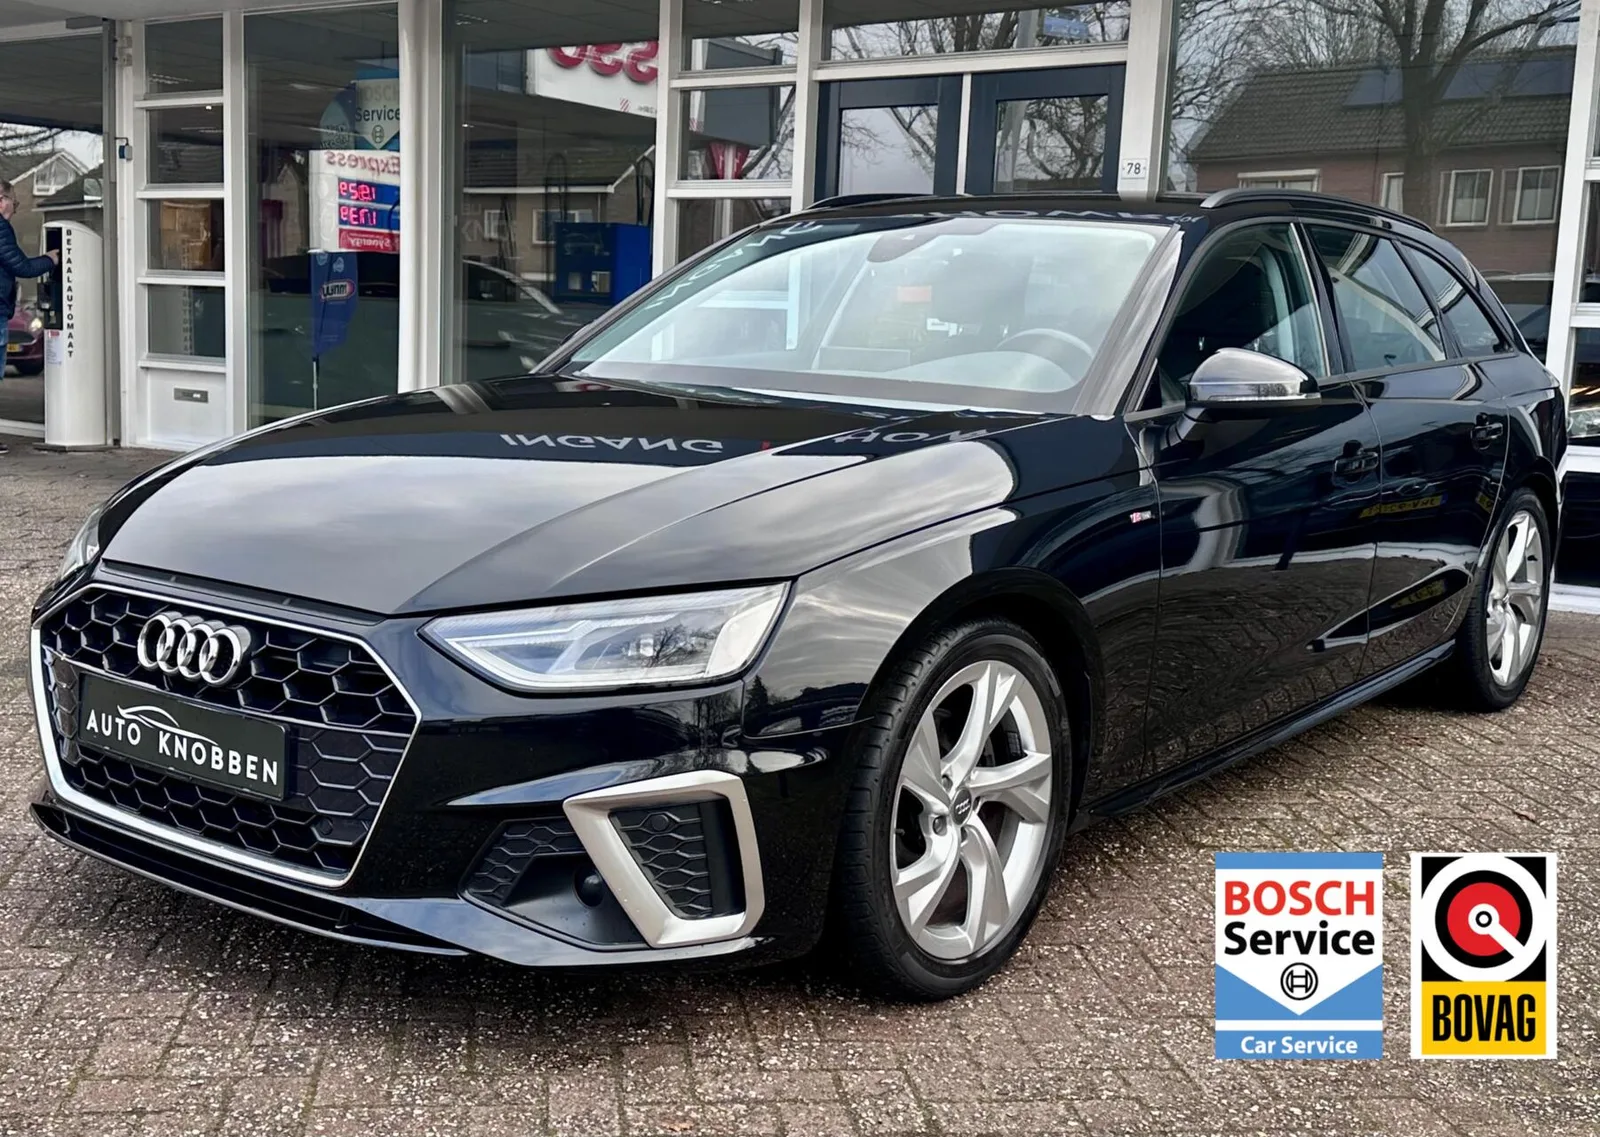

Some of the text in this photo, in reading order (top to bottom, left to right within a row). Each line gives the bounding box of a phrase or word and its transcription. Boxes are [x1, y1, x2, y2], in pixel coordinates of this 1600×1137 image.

[1127, 162, 1141, 175] 78
[65, 228, 75, 358] BETAALAUTOMAAT
[86, 708, 278, 786] AUTO KNOBBEN
